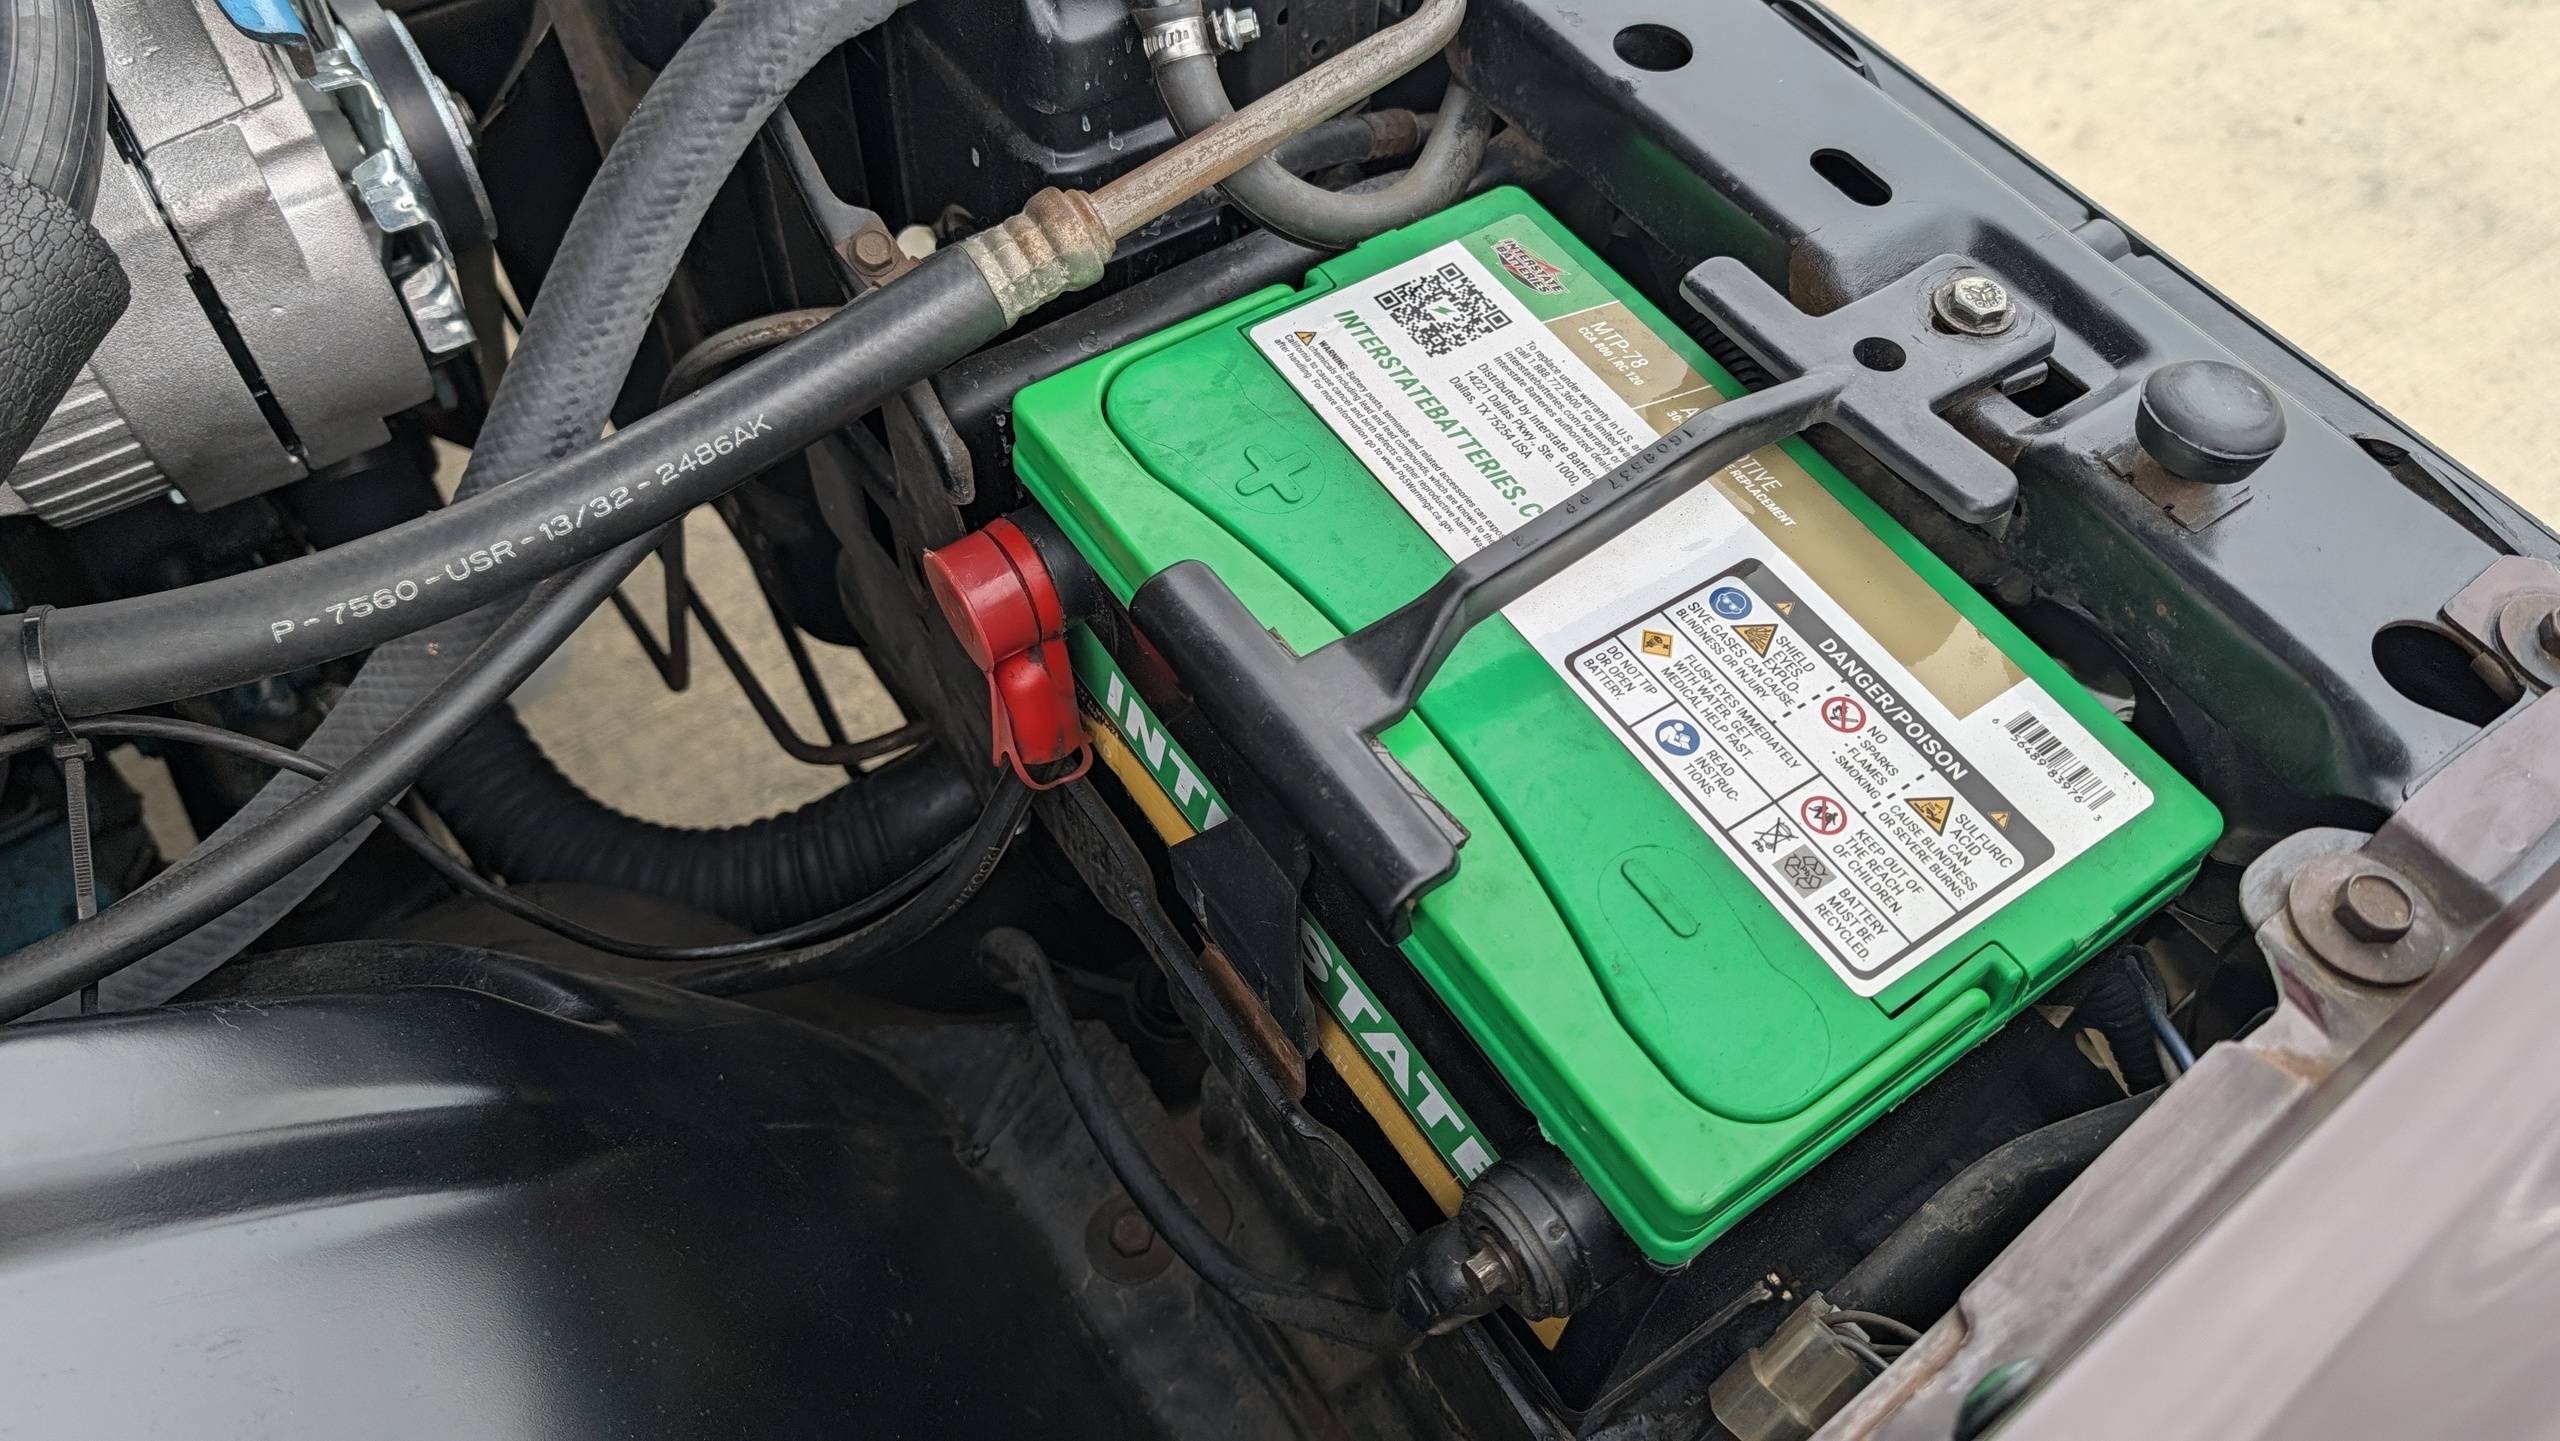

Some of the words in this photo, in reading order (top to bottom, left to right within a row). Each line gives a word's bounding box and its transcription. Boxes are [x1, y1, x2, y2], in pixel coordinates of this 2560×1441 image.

[1495, 245, 1550, 292] BATTERIES
[1503, 240, 1564, 292] INTERSTATE
[1577, 326, 1598, 343] CCA
[1593, 341, 1614, 357] 800
[1612, 359, 1629, 372] RC
[1624, 370, 1644, 386] 120
[1589, 320, 1649, 368] MTP-78
[1448, 375, 1476, 404] Dallas,
[1474, 401, 1492, 416] TX
[1486, 413, 1516, 441] 75254
[1510, 438, 1532, 459] USA
[1476, 362, 1524, 405] Distributed
[1517, 402, 1532, 416] by
[1527, 413, 1569, 453] Interstate
[1492, 355, 1527, 388] Interstate
[1523, 385, 1557, 418] Batteries
[1553, 416, 1595, 453] authorized
[1589, 451, 1613, 473] deale
[1502, 350, 1613, 456] interstatebatteries.com/warranty
[1609, 454, 1622, 464] or
[1513, 345, 1532, 360] call
[1527, 357, 1583, 411] 1.888.772.3600.
[1579, 408, 1596, 423] For
[1592, 420, 1622, 447] limited
[1525, 339, 1537, 351] To
[1533, 349, 1562, 375] replace
[1558, 373, 1582, 393] under
[1578, 391, 1611, 422] warranty
[1607, 419, 1619, 430] in
[1615, 427, 1634, 444] U.S.
[1273, 338, 1290, 353] after
[1286, 351, 1312, 380] handling.
[1310, 378, 1324, 390] For
[1319, 388, 1338, 406] more
[1334, 404, 1369, 440] information
[1363, 438, 1376, 448] go
[1373, 446, 1383, 456] to
[1380, 454, 1454, 534] www.P65Warnings.ca.gov.
[1283, 333, 1312, 363] California
[1308, 360, 1318, 369] to
[1314, 368, 1335, 387] cause
[1330, 385, 1353, 407] cancer
[1349, 406, 1366, 419] and
[1360, 416, 1377, 434] birth
[1373, 432, 1398, 456] defects
[1394, 455, 1405, 463] or
[1401, 462, 1420, 479] other
[1416, 478, 1455, 518] reproductive
[1452, 515, 1471, 537] harm.
[1307, 344, 1337, 375] chemicals
[1334, 373, 1362, 402] including
[1358, 398, 1376, 415] lead
[1370, 413, 1387, 426] and
[1381, 423, 1399, 440] lead
[1393, 438, 1430, 476] compounds,
[1427, 474, 1448, 494] which
[1444, 493, 1458, 505] are
[1454, 502, 1478, 526] known
[1474, 524, 1485, 533] to
[1317, 339, 1349, 372] WARNING:
[1345, 369, 1368, 392] Battery
[1362, 391, 1384, 411] posts,
[1381, 409, 1411, 438] terminals
[1407, 436, 1424, 450] and
[1418, 448, 1444, 472] related
[1438, 470, 1476, 508] accessories
[1472, 506, 1488, 520] can
[1463, 369, 1492, 395] 14221
[1486, 393, 1515, 420] Dallas
[1510, 417, 1536, 446] Pkwy.,
[1536, 443, 1554, 462] Ste.
[1554, 460, 1580, 486] 1000,
[1729, 468, 1797, 526] REPLACEMENT
[1582, 657, 1625, 700] BATTERY.
[1594, 651, 1612, 667] OR
[1607, 665, 1637, 692] OPEN
[1605, 644, 1624, 660] DO
[1619, 658, 1644, 679] NOT
[1638, 677, 1658, 694] TIP
[1674, 607, 1725, 655] BLINDNESS
[1721, 653, 1738, 669] OR
[1733, 666, 1770, 701] INJURY.
[1686, 600, 1715, 626] SIVE
[1709, 623, 1747, 658] GASES
[1742, 656, 1766, 678] CAN
[1762, 676, 1796, 707] CAUSE
[1761, 656, 1799, 694] EXPLO-
[1771, 649, 1803, 681] EYES.
[1775, 635, 1816, 672] SHIELD
[1659, 666, 1702, 709] MEDICAL
[1699, 706, 1729, 732] HELP
[1724, 732, 1753, 760] FAST.
[1672, 659, 1701, 686] WITH
[1696, 683, 1731, 721] WATER.
[1729, 719, 1754, 739] GET
[1683, 653, 1718, 685] FLUSH
[1711, 682, 1740, 708] EYES
[1735, 706, 1801, 768] IMMEDIATELY
[1817, 637, 1968, 780] DANGER/POISON
[1704, 748, 1735, 776] READ
[1859, 739, 1899, 776] SPARKS
[1866, 724, 1888, 744] NO
[1682, 761, 1715, 798] TIONS.
[1693, 755, 1739, 801] INSTRUC-
[1834, 754, 1881, 799] SMOKING
[1846, 746, 1888, 786] FLAMES
[2009, 732, 2047, 766] 56489
[2046, 768, 2088, 803] 83976
[2092, 813, 2102, 822] 3
[1750, 838, 1764, 853] Pb
[1844, 835, 1870, 860] THE
[1864, 857, 1905, 896] REACH
[1854, 828, 1886, 855] KEEP
[1882, 856, 1909, 879] OUT
[1904, 878, 1924, 893] OF
[1877, 811, 1896, 828] OR
[1892, 826, 1933, 864] SEVERE
[1927, 862, 1965, 898] BURNS.
[1889, 804, 1925, 838] CAUSE
[1920, 835, 1978, 891] BLINDNESS
[1946, 843, 1972, 867] CAN
[1948, 828, 1982, 856] ACID
[1954, 812, 2013, 868] SULFURIC
[1831, 843, 1852, 858] OF
[1847, 859, 1902, 916] CHILDREN.
[1813, 902, 1869, 962] RECYCLED.
[1825, 894, 1861, 927] MUST
[1855, 925, 1876, 944] BE
[1837, 887, 1888, 935] BATTERY
